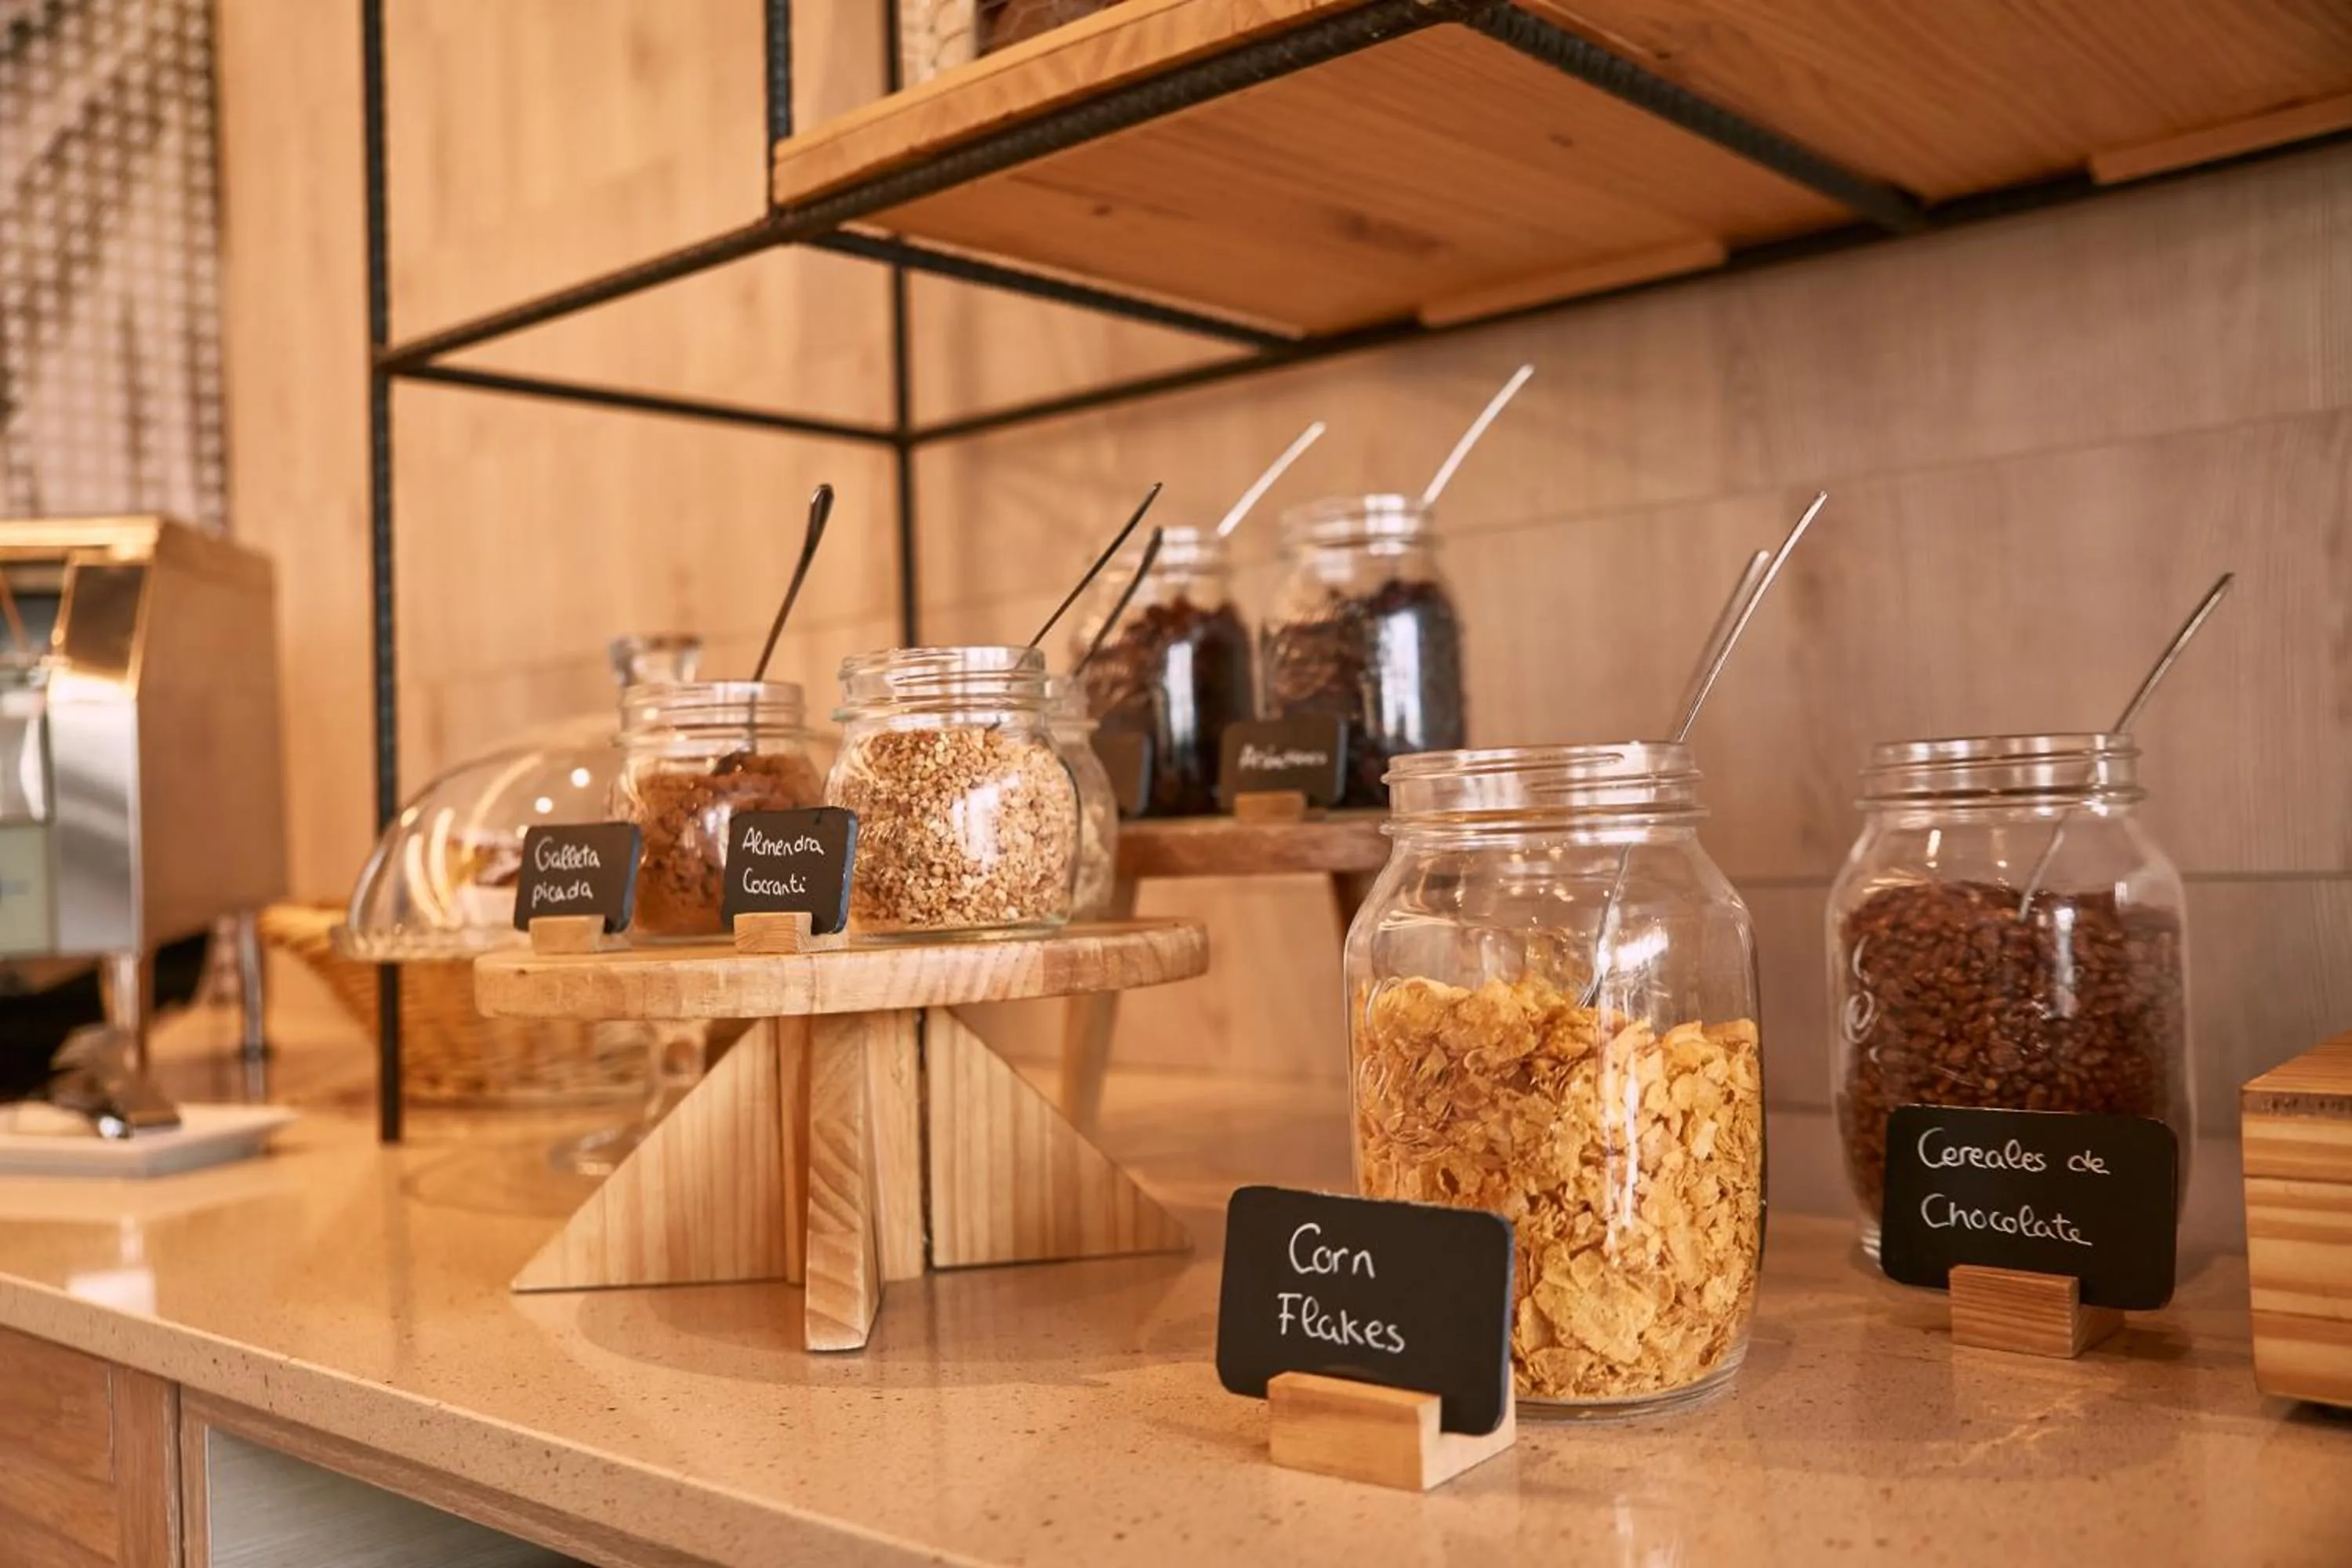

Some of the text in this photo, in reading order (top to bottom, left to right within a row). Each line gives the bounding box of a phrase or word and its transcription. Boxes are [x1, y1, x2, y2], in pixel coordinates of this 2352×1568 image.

[535, 837, 600, 871] Galleta
[742, 827, 824, 855] Almendra
[532, 880, 593, 907] picada
[1918, 1128, 2110, 1174] Cereales de
[1922, 1193, 2092, 1245] Chocolate
[1289, 1223, 1374, 1278] Corn
[1278, 1293, 1405, 1353] Flakes
